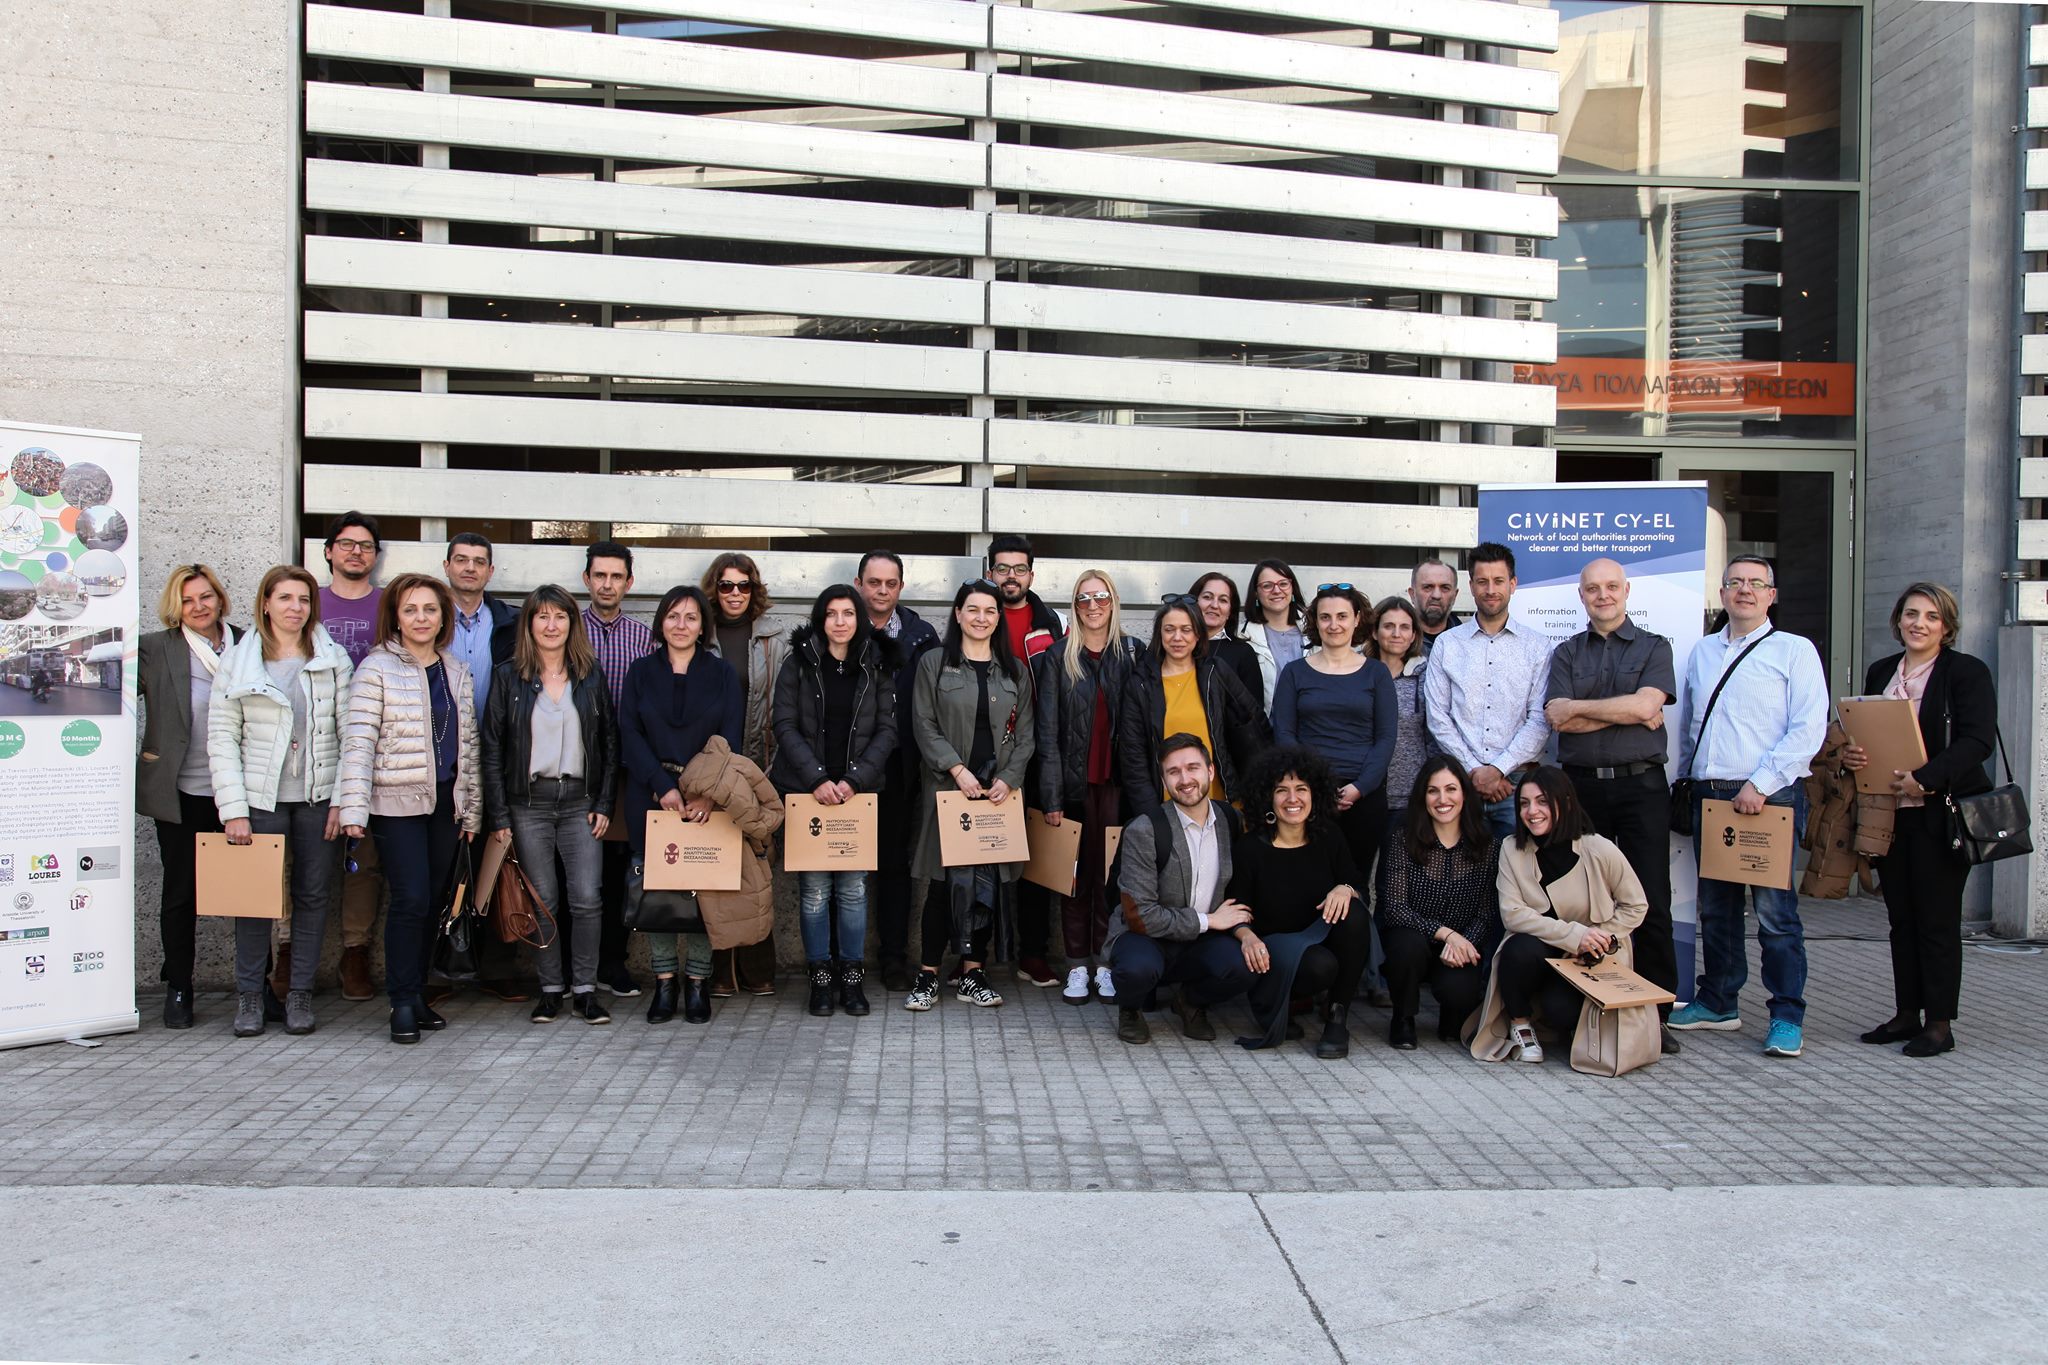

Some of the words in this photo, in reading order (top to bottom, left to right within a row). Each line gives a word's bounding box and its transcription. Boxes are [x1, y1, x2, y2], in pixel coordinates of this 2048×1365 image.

[1594, 373, 1721, 397] ΠΟΛΛΑΠΛΩΝ
[1732, 377, 1828, 398] ΧΡΗΣΕΩΝ
[1614, 513, 1675, 529] CY-EL
[1507, 533, 1544, 542] Network
[1547, 533, 1556, 542] of
[1559, 533, 1579, 542] local
[1581, 533, 1627, 542] authorities
[1630, 533, 1675, 543] promoting
[1528, 544, 1559, 552] cleaner
[1562, 544, 1579, 552] and
[1582, 544, 1608, 552] better
[1611, 544, 1652, 554] transport
[1544, 621, 1577, 630] training
[28, 871, 61, 880] LOURES
